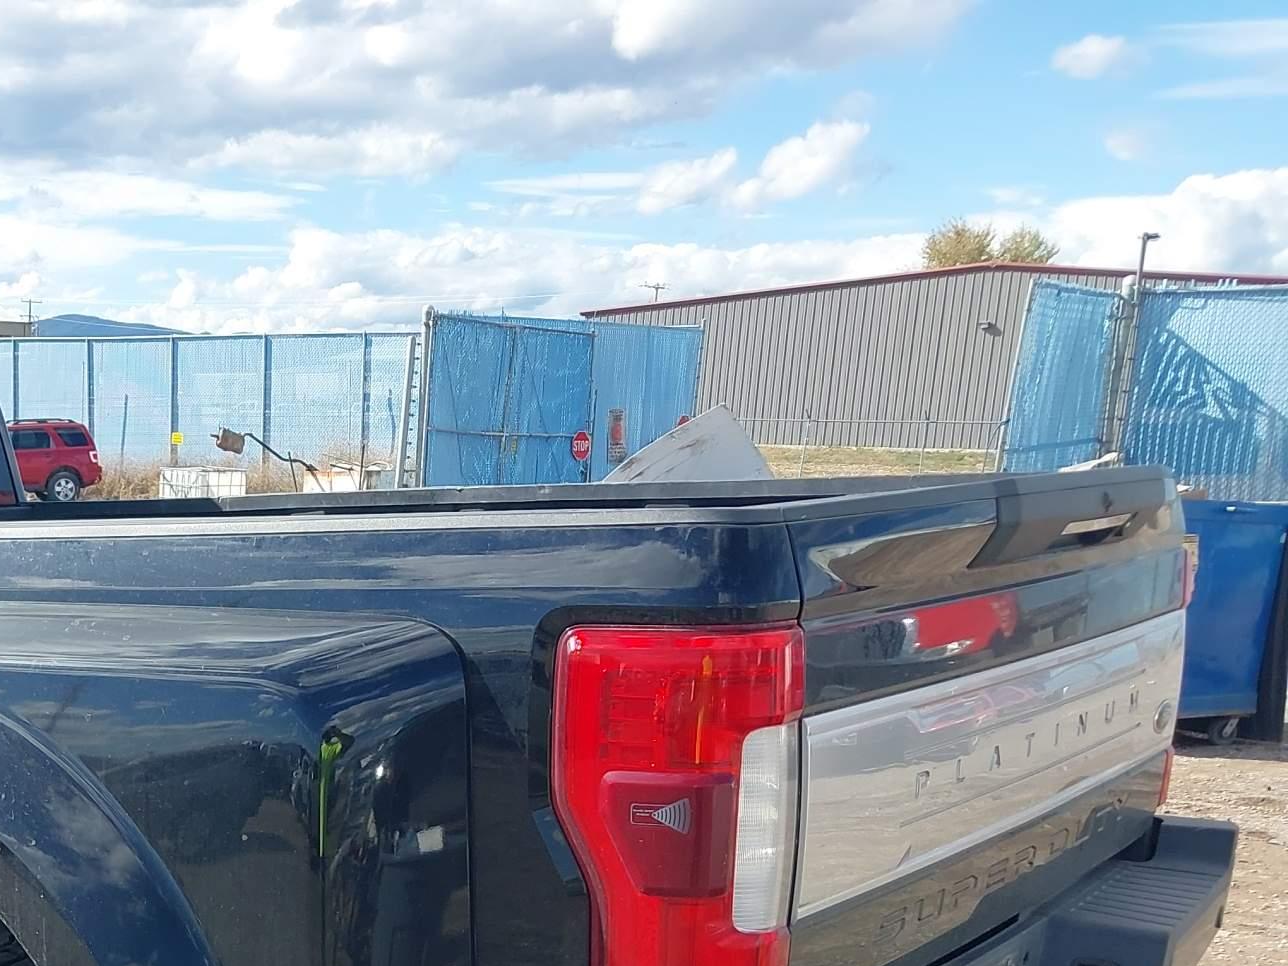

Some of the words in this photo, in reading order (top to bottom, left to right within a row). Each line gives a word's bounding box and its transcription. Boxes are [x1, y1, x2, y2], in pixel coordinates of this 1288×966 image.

[573, 440, 589, 452] STOP
[914, 689, 1140, 799] PLATINUM
[873, 845, 1037, 947] SUPER
